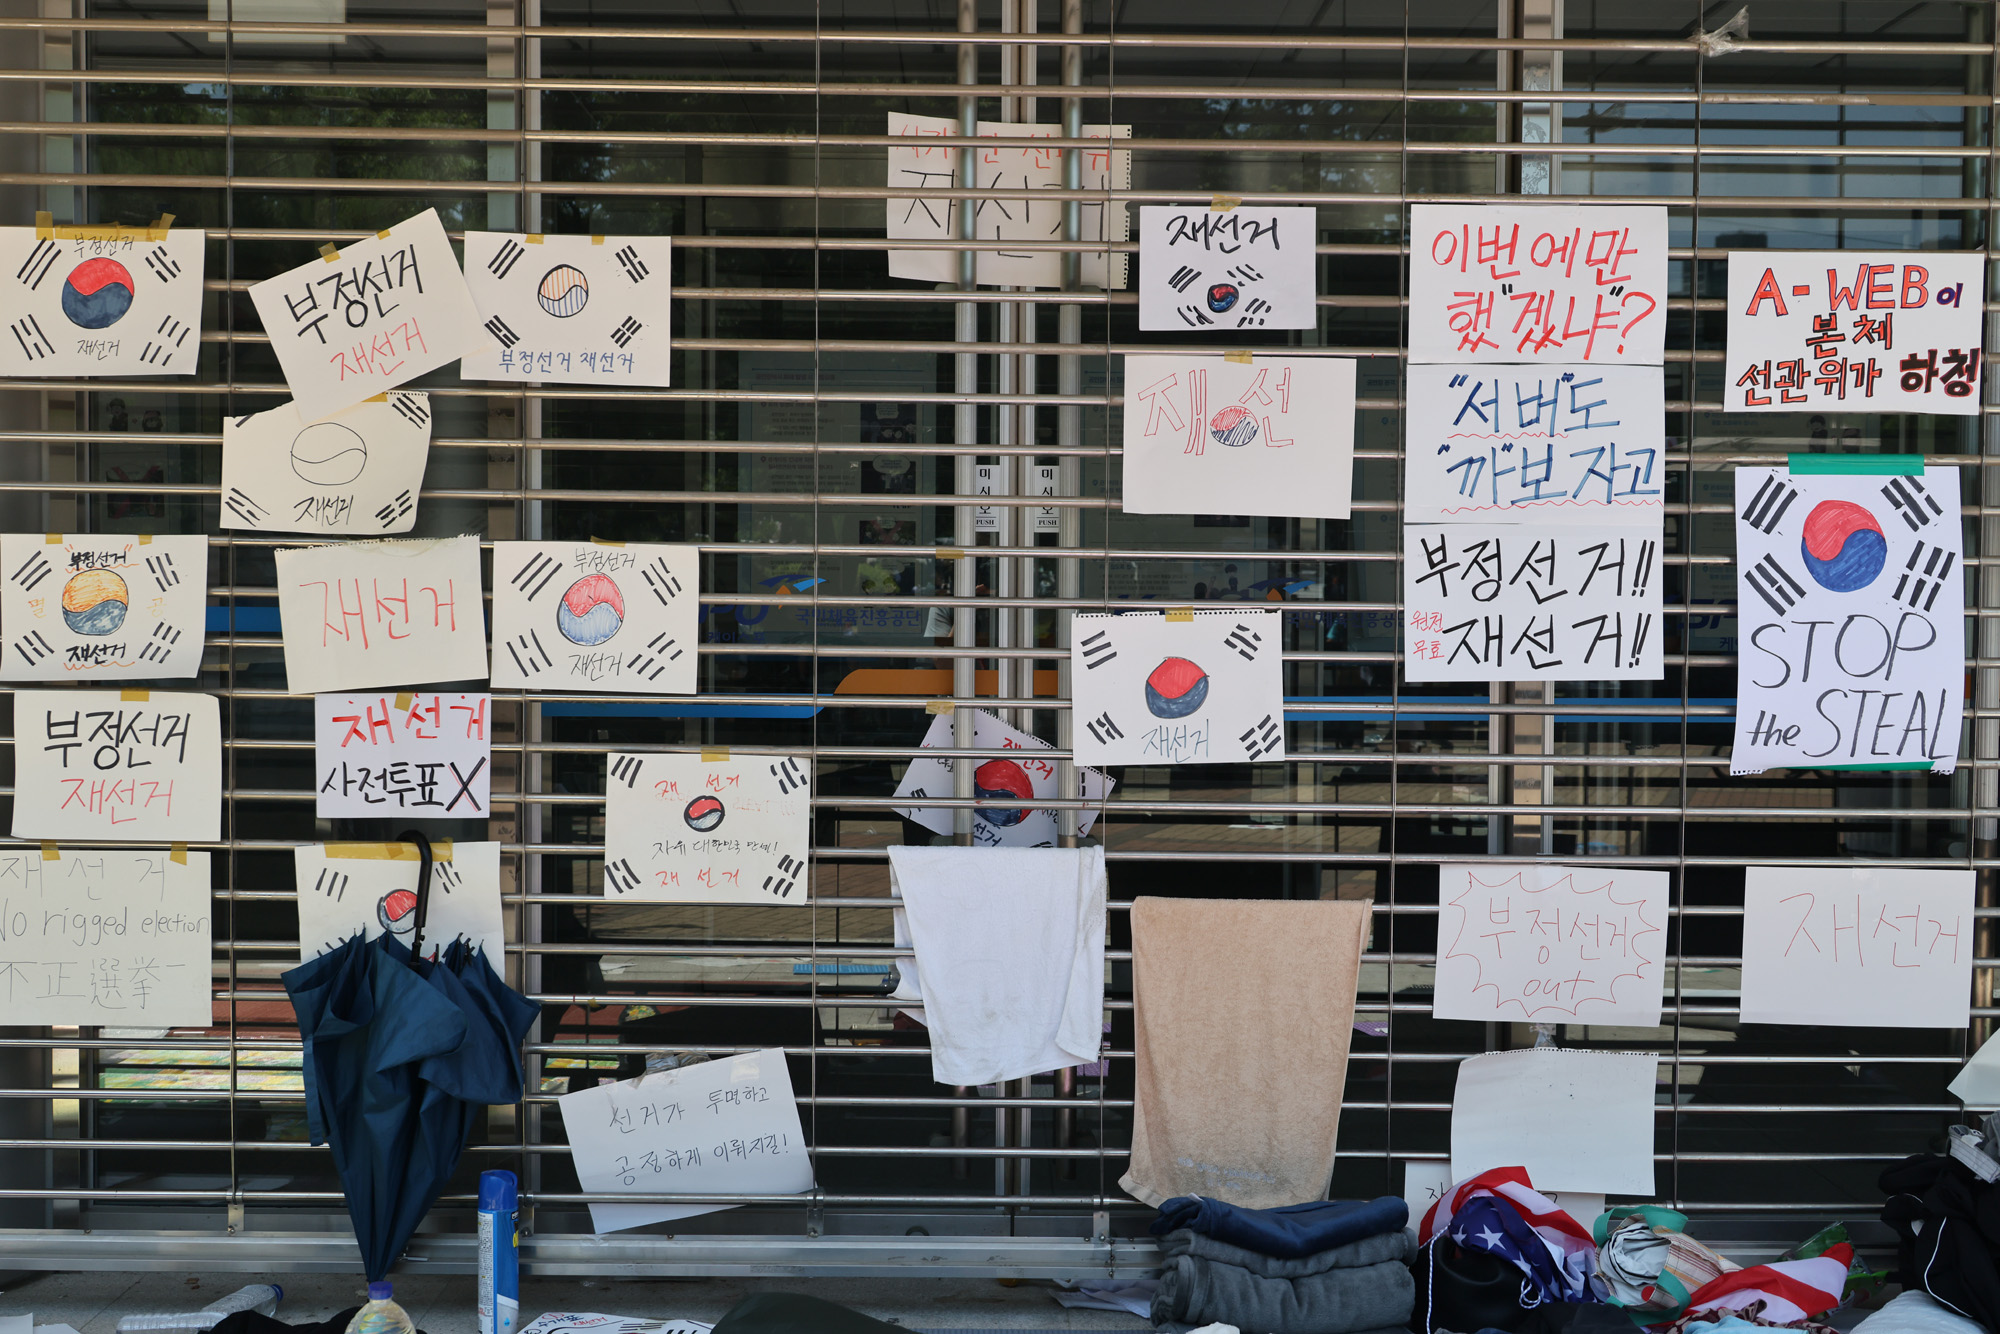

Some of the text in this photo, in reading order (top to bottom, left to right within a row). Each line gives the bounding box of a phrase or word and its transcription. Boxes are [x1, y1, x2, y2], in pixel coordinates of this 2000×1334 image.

[74, 232, 135, 258] 부정선거
[1166, 213, 1281, 255] 재선거
[1431, 223, 1638, 286] 이번에만
[283, 243, 424, 344] 부정선거
[77, 339, 121, 361] 재선거
[329, 317, 428, 382] 재선거
[1805, 312, 1893, 359] 본체
[498, 349, 635, 375] 부정선거 재선거
[1735, 347, 1981, 406] 선관위가 하청
[293, 493, 354, 527] 재선거
[573, 547, 636, 573] 부정선거
[299, 578, 456, 650] 재선거
[1410, 610, 1443, 633] 원천
[65, 642, 127, 665] 재선거
[568, 652, 623, 681] 재선거
[1412, 640, 1445, 660] 무효
[1751, 612, 1937, 688] STOP
[44, 710, 191, 770] 부정선거
[1141, 718, 1209, 763] 재선거
[1746, 688, 1954, 760] the STEAL
[60, 778, 174, 825] 재선거
[692, 838, 741, 855] 대한민국
[43, 906, 128, 947] rigged
[141, 909, 210, 938] election
[1479, 896, 1627, 965] 부정선거
[1779, 893, 1960, 967] 재선거
[1523, 970, 1595, 1000] out
[609, 1086, 770, 1134] 선거가 투명하고
[615, 1147, 701, 1186] 공정하게
